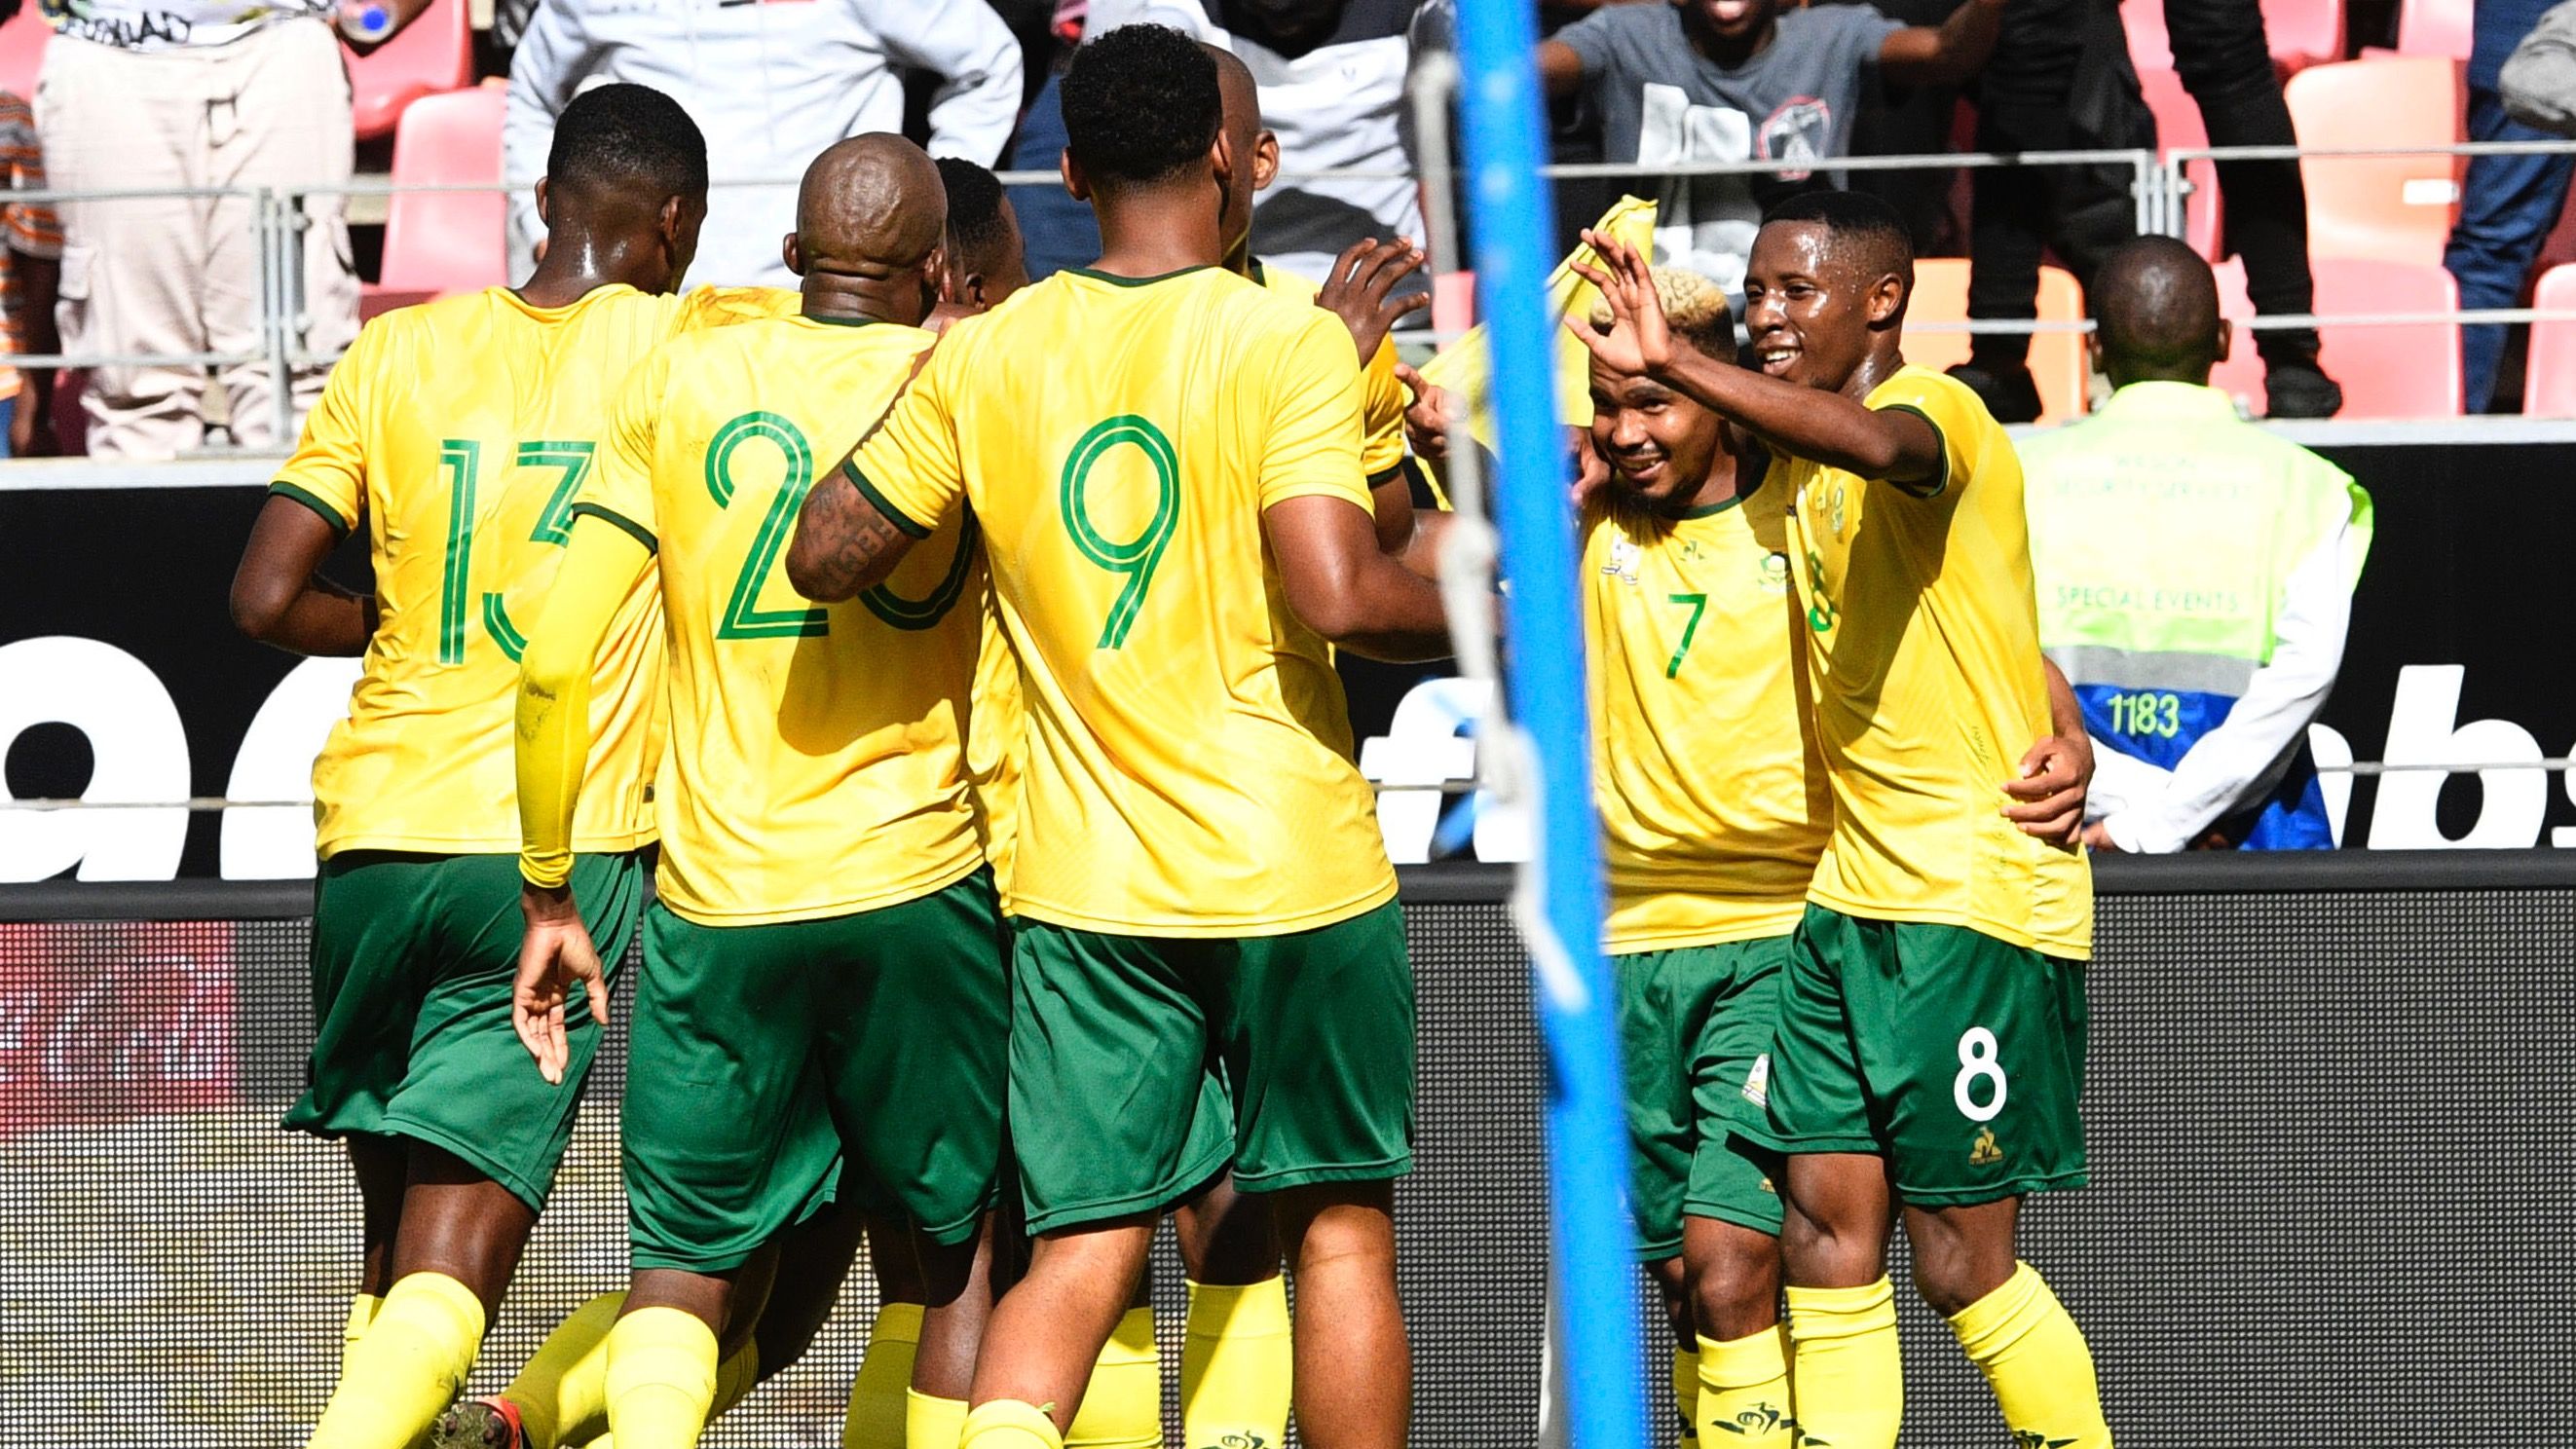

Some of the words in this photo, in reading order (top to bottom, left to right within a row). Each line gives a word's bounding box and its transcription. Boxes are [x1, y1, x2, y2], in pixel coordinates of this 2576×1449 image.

[1061, 414, 1180, 650] 9
[1666, 593, 1708, 680] 7
[2057, 584, 2143, 610] SPECIAL
[2153, 587, 2239, 613] EVENTS
[2108, 692, 2181, 739] 1183
[1953, 1025, 2007, 1122] 8
